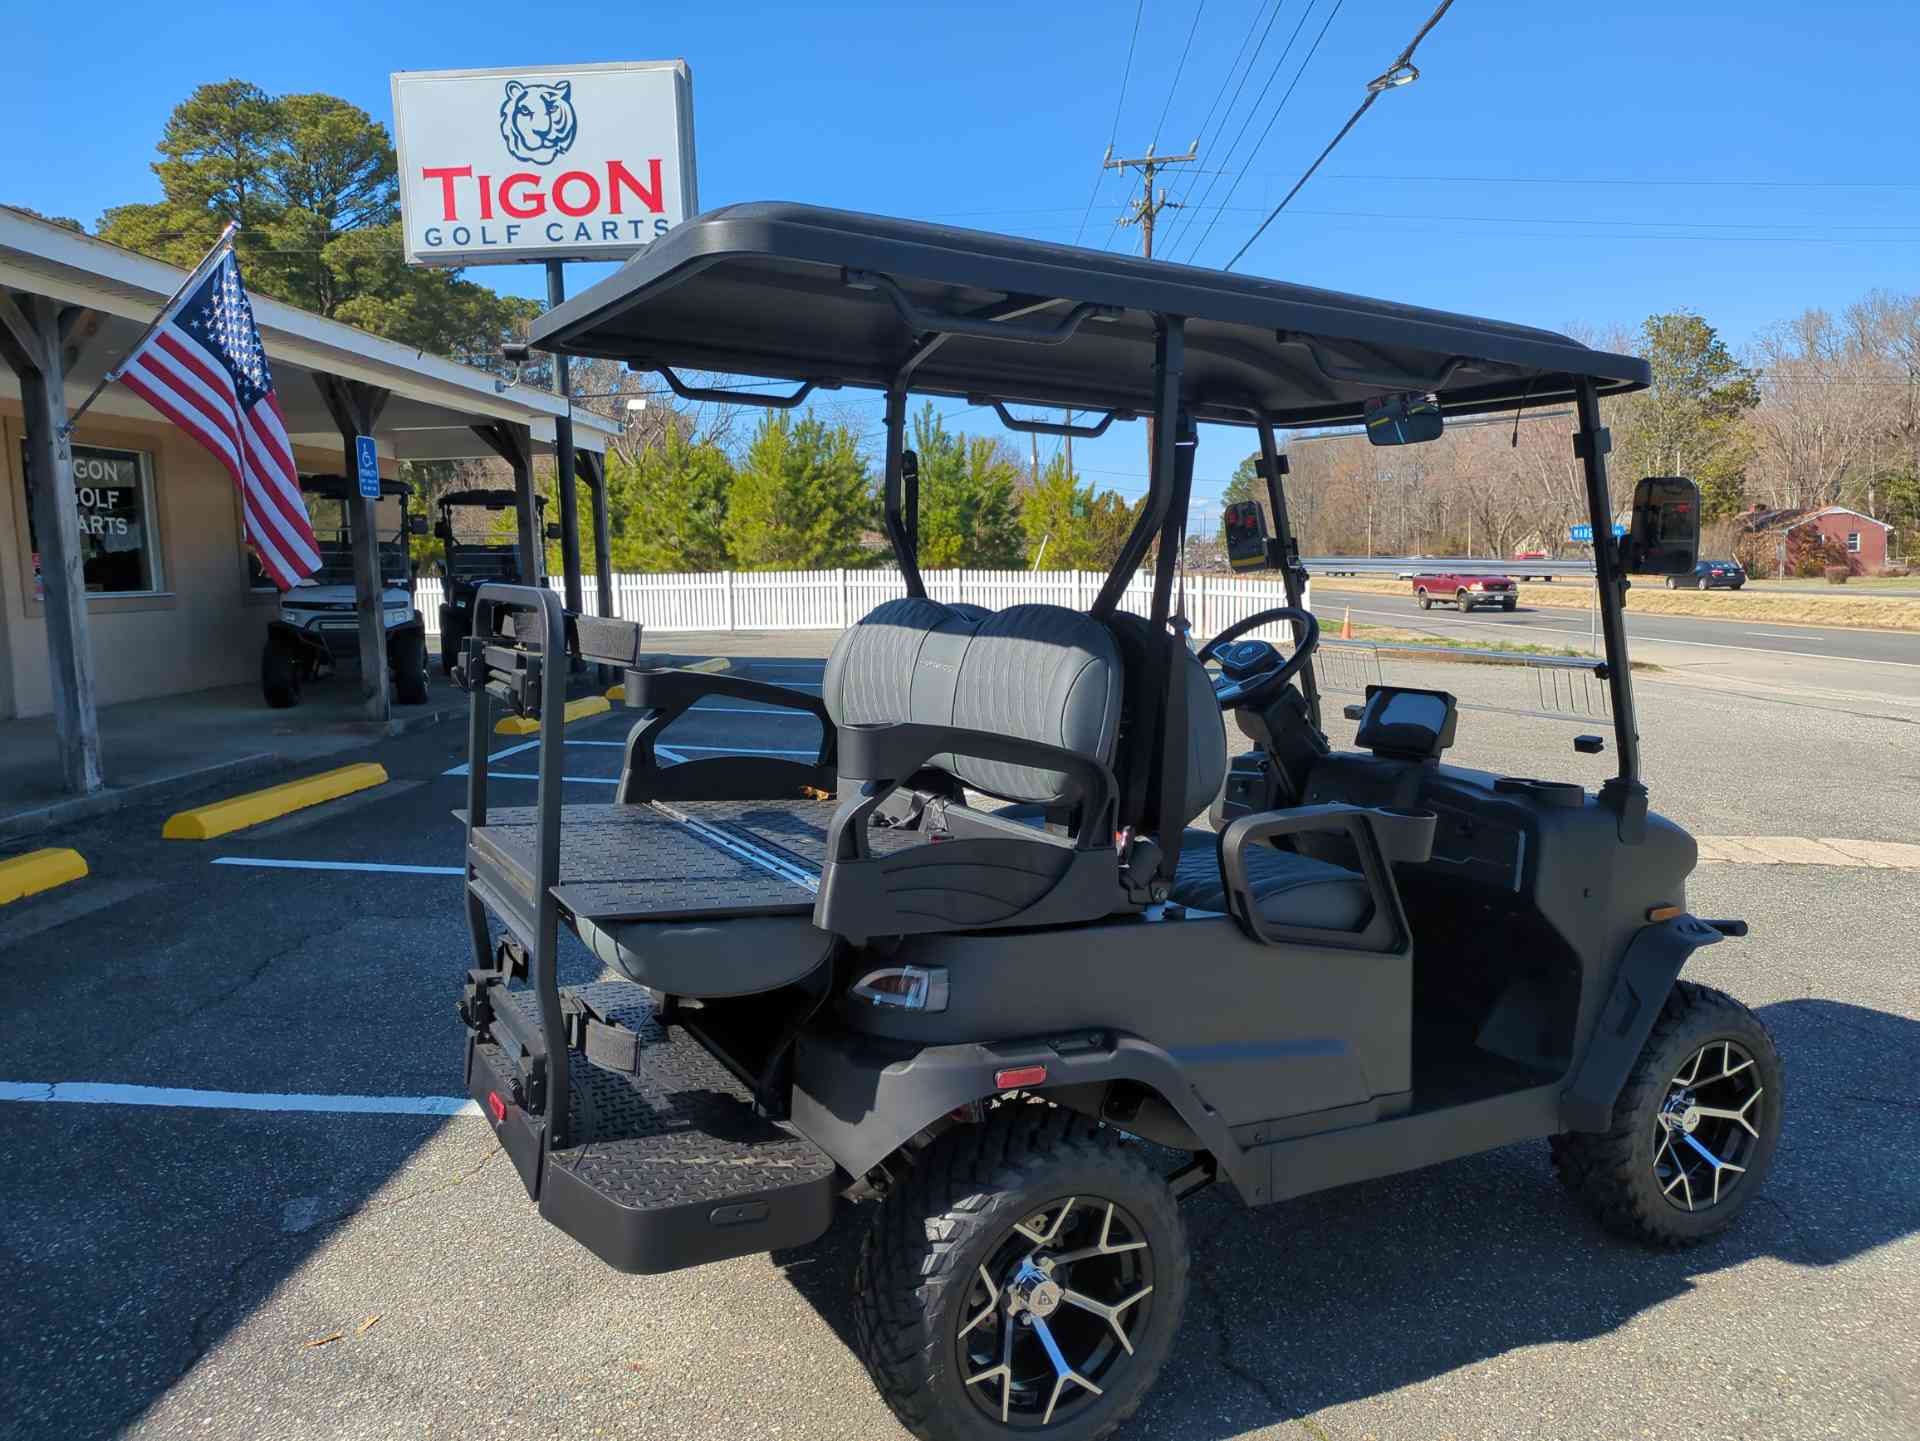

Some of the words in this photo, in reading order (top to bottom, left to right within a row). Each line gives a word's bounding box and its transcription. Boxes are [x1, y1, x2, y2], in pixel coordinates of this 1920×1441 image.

[422, 159, 665, 221] TIGON
[424, 224, 521, 247] GOLF
[546, 218, 669, 242] CARTS
[73, 458, 119, 480] GON
[79, 515, 129, 535] ARTS
